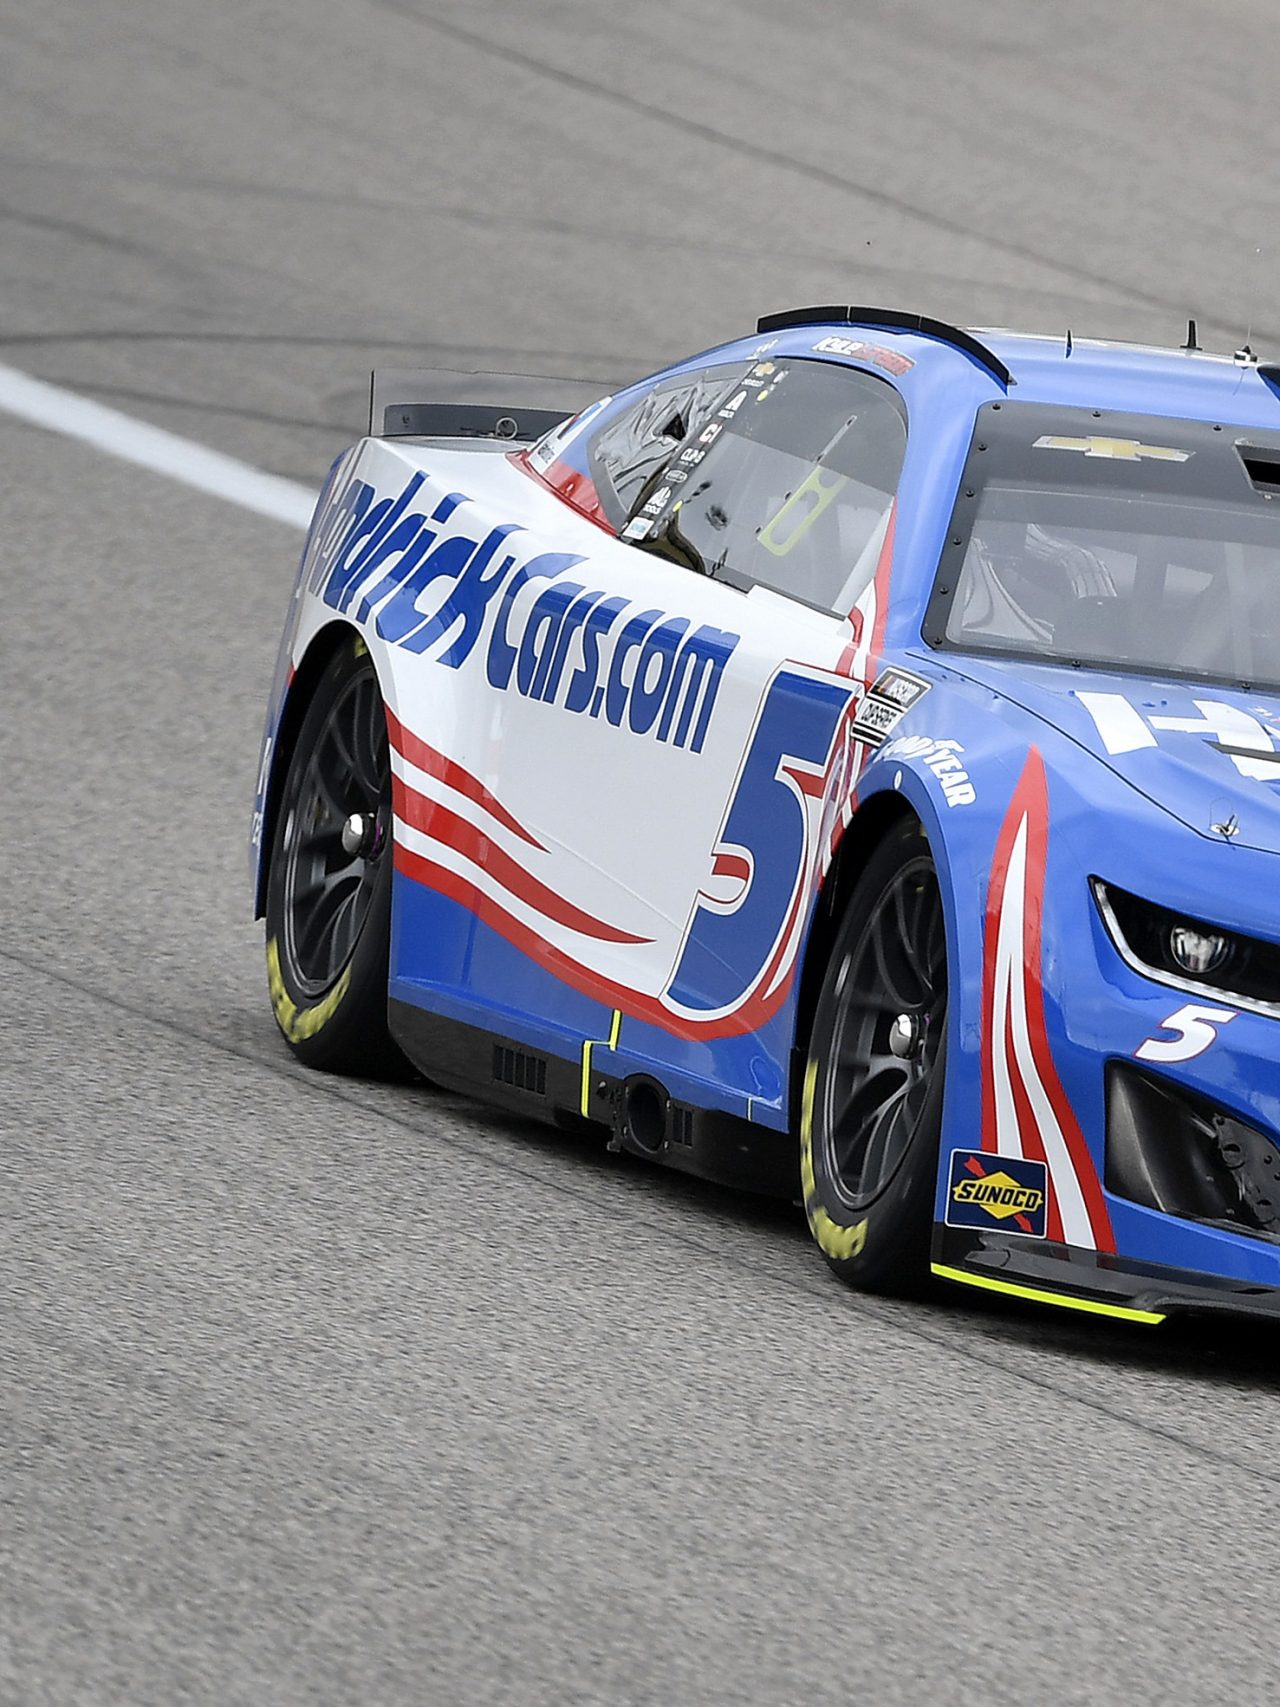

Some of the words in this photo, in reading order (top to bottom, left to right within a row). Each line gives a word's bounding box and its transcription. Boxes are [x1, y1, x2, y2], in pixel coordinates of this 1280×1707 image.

[661, 666, 861, 1016] 5
[1134, 1003, 1240, 1063] 5
[959, 1179, 1040, 1211] SUNOCO
